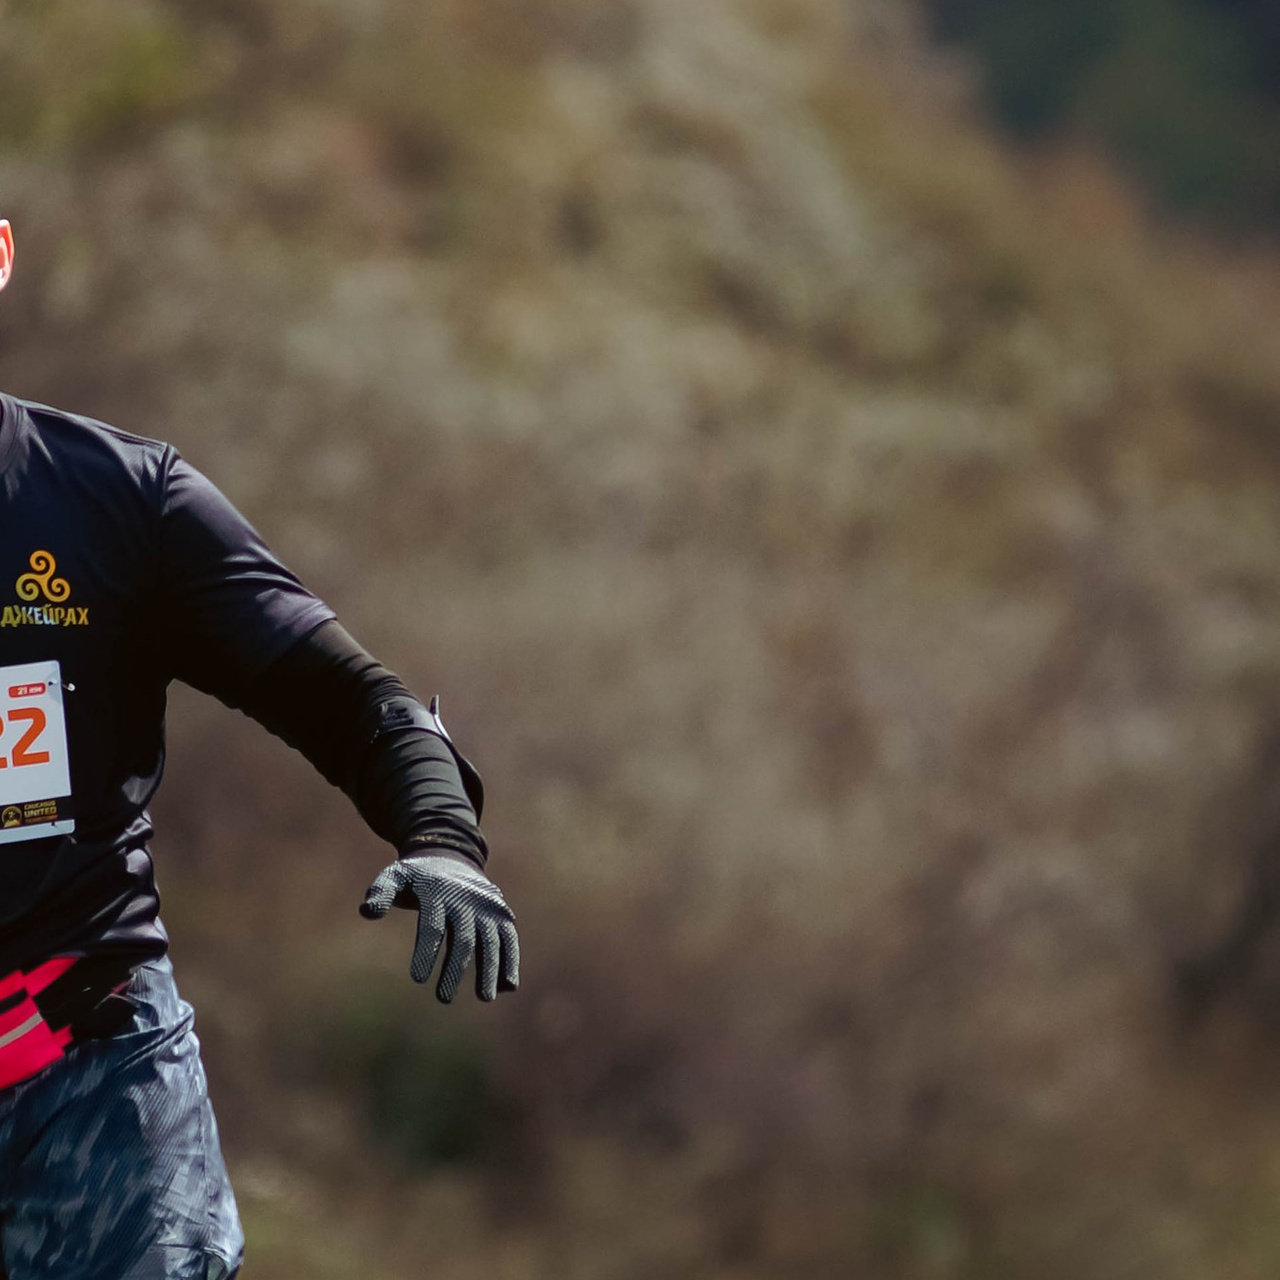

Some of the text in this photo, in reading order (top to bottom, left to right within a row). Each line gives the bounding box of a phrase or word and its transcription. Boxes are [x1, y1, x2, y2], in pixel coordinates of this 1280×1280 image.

[0, 604, 89, 627] ДЖЕЙРАХ
[17, 686, 28, 696] 21
[24, 806, 57, 818] UNITED
